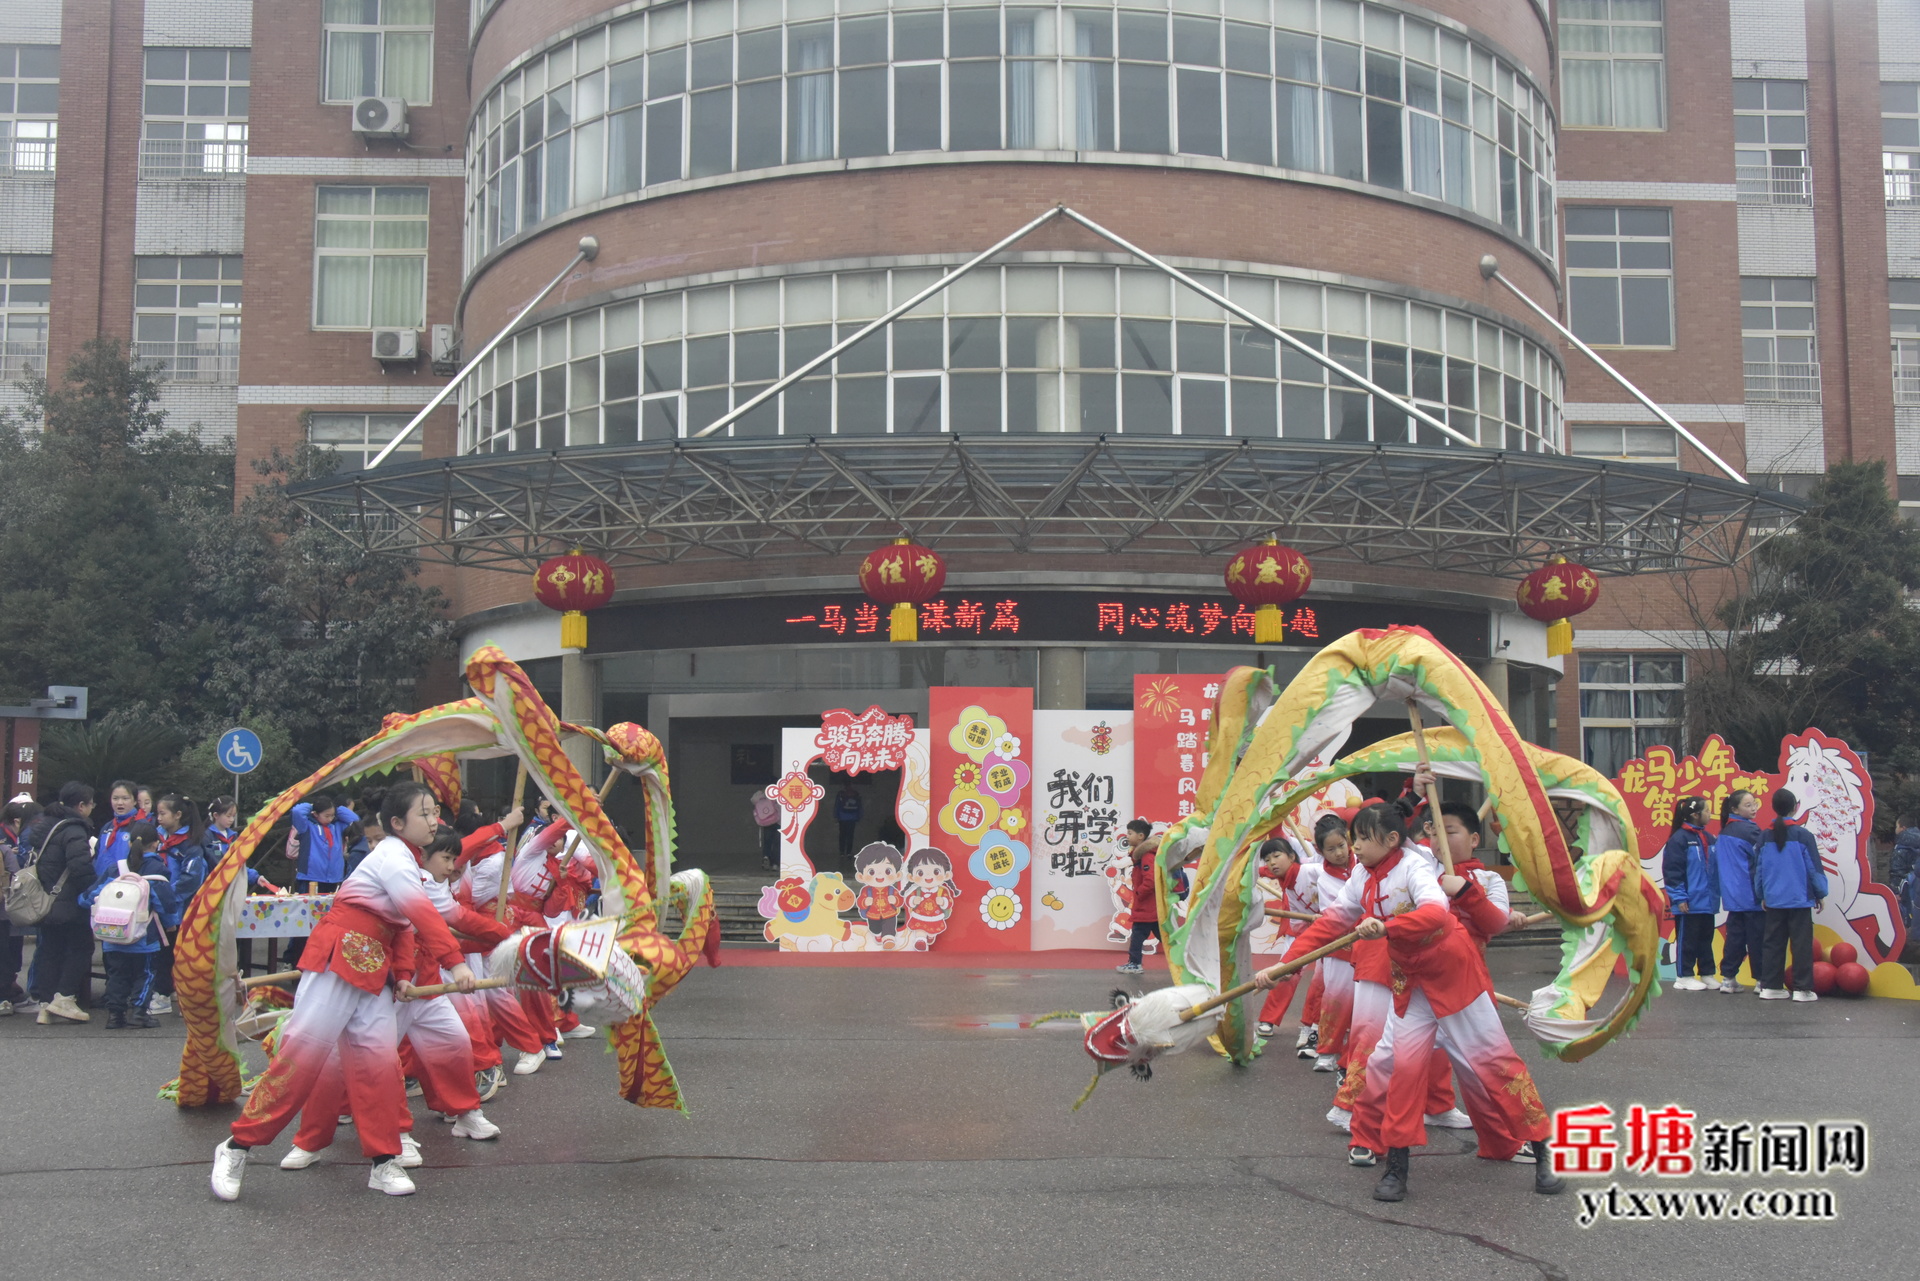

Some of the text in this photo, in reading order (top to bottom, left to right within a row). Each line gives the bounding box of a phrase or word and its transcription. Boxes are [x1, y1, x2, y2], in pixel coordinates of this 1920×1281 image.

[878, 554, 938, 585] 佳节
[786, 599, 1319, 638] 一马当谋新篇 同心筑梦向越
[818, 722, 912, 749] 骏马奔腾
[970, 724, 988, 737] 未来
[967, 732, 985, 746] 可期
[991, 768, 1009, 780] 学业
[1621, 739, 1735, 794] 龙马少年
[993, 776, 1012, 789] 有成
[1047, 768, 1114, 809] 我们
[788, 785, 803, 800] 福
[962, 804, 981, 818] 元气
[959, 812, 977, 827] 满满
[1045, 808, 1117, 846] 开学
[990, 849, 1008, 861] 快乐
[1051, 845, 1100, 878] 啦
[993, 859, 1011, 871] 成长
